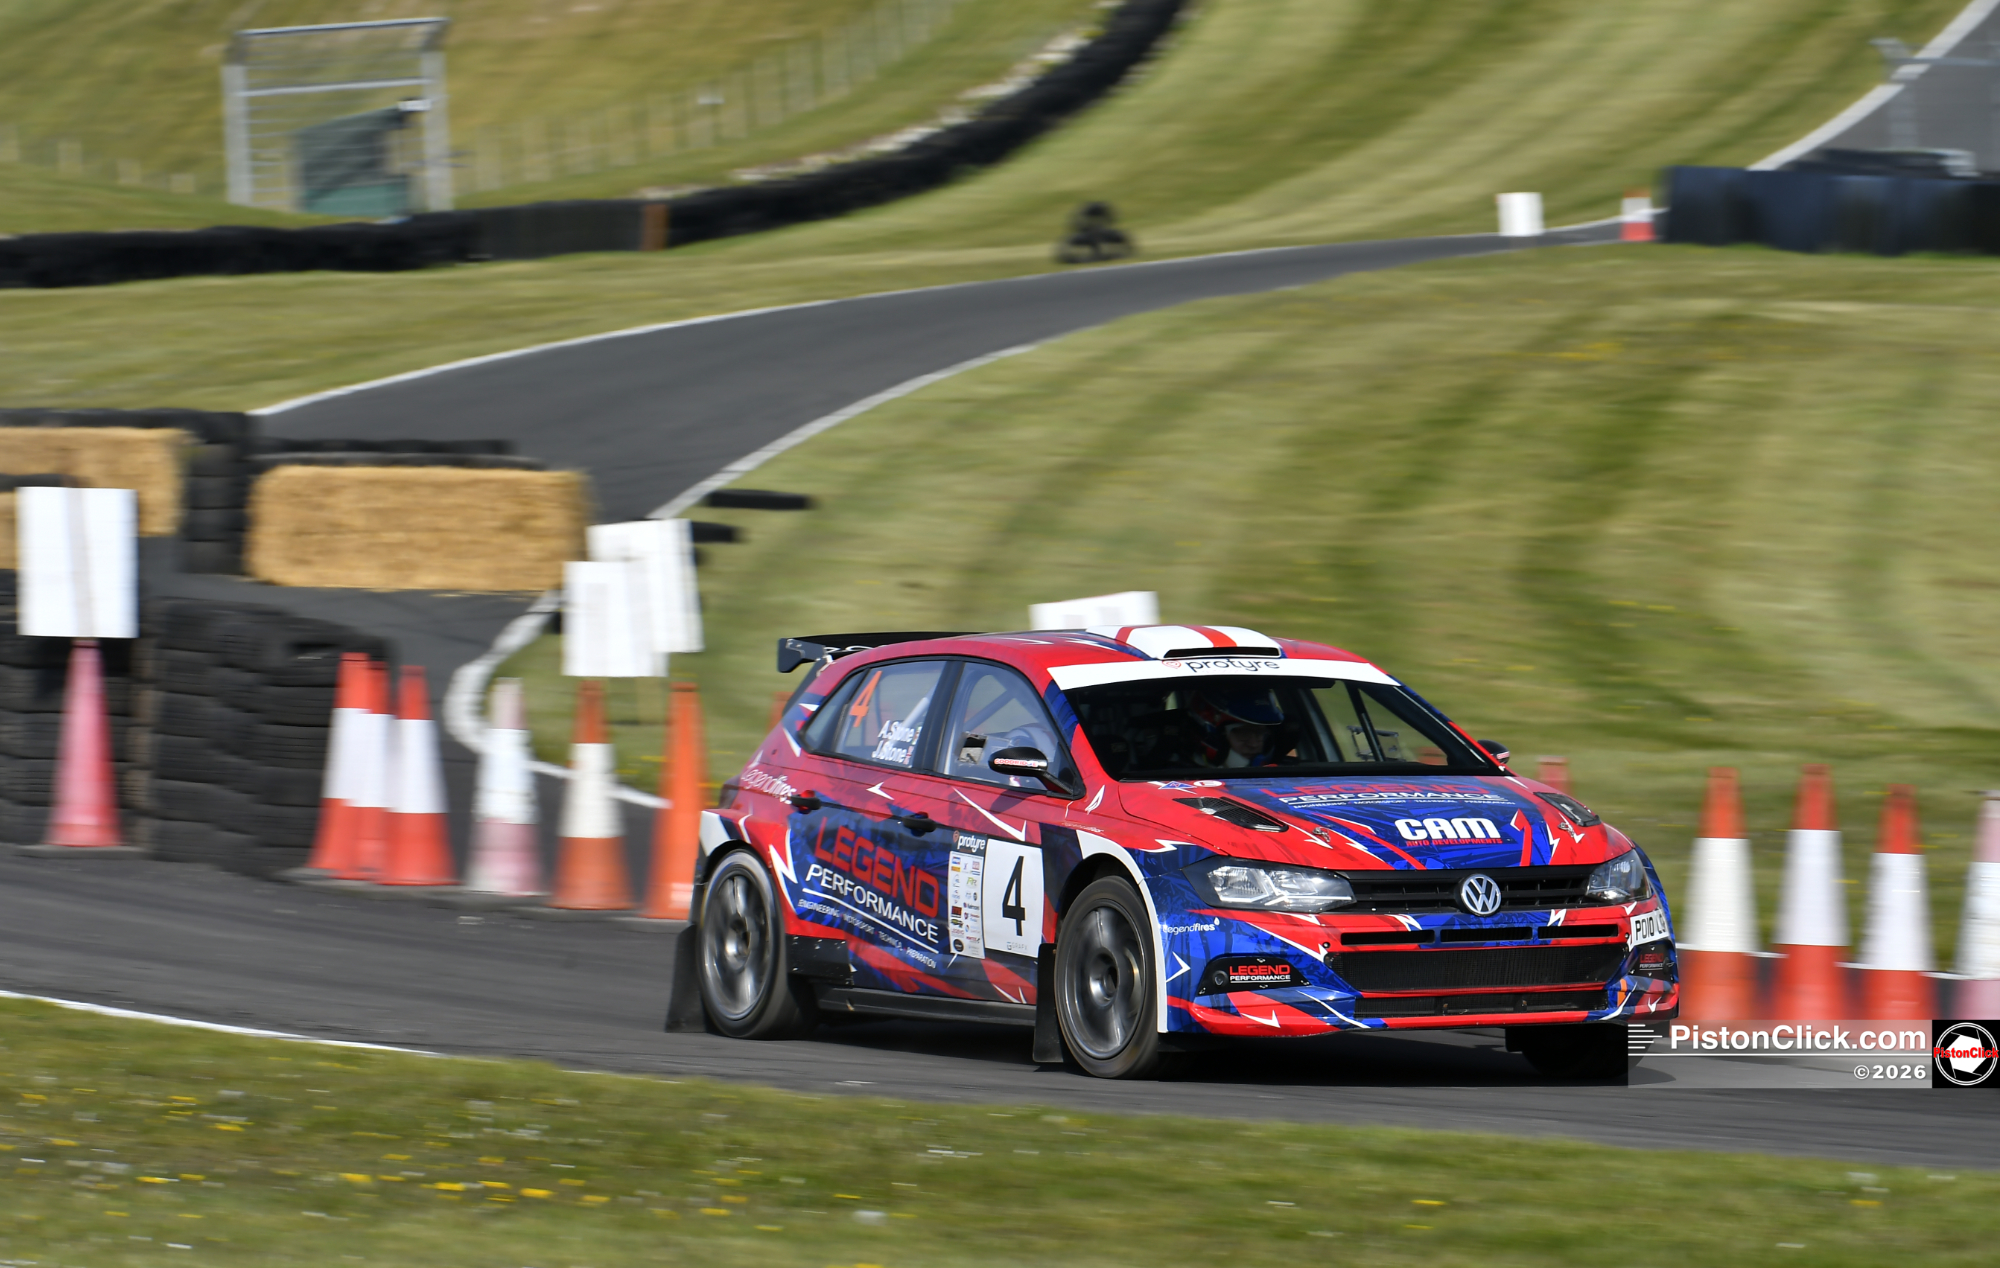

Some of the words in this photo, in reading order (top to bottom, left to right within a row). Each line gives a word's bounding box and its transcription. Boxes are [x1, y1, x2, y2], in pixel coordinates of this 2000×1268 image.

[1185, 658, 1280, 673] protyre
[849, 670, 883, 728] 4
[1259, 783, 1493, 798] LEGEND
[1278, 791, 1508, 804] PERFORMANCE
[1394, 817, 1501, 840] CAM
[957, 834, 986, 853] protyre
[1432, 838, 1503, 846] DEVELOPMENTS
[814, 816, 940, 918] LEGEND
[805, 863, 939, 944] PERFORMANCE
[1001, 855, 1026, 937] 4
[1640, 953, 1664, 963] LEGEND
[1229, 964, 1291, 976] LEGEND
